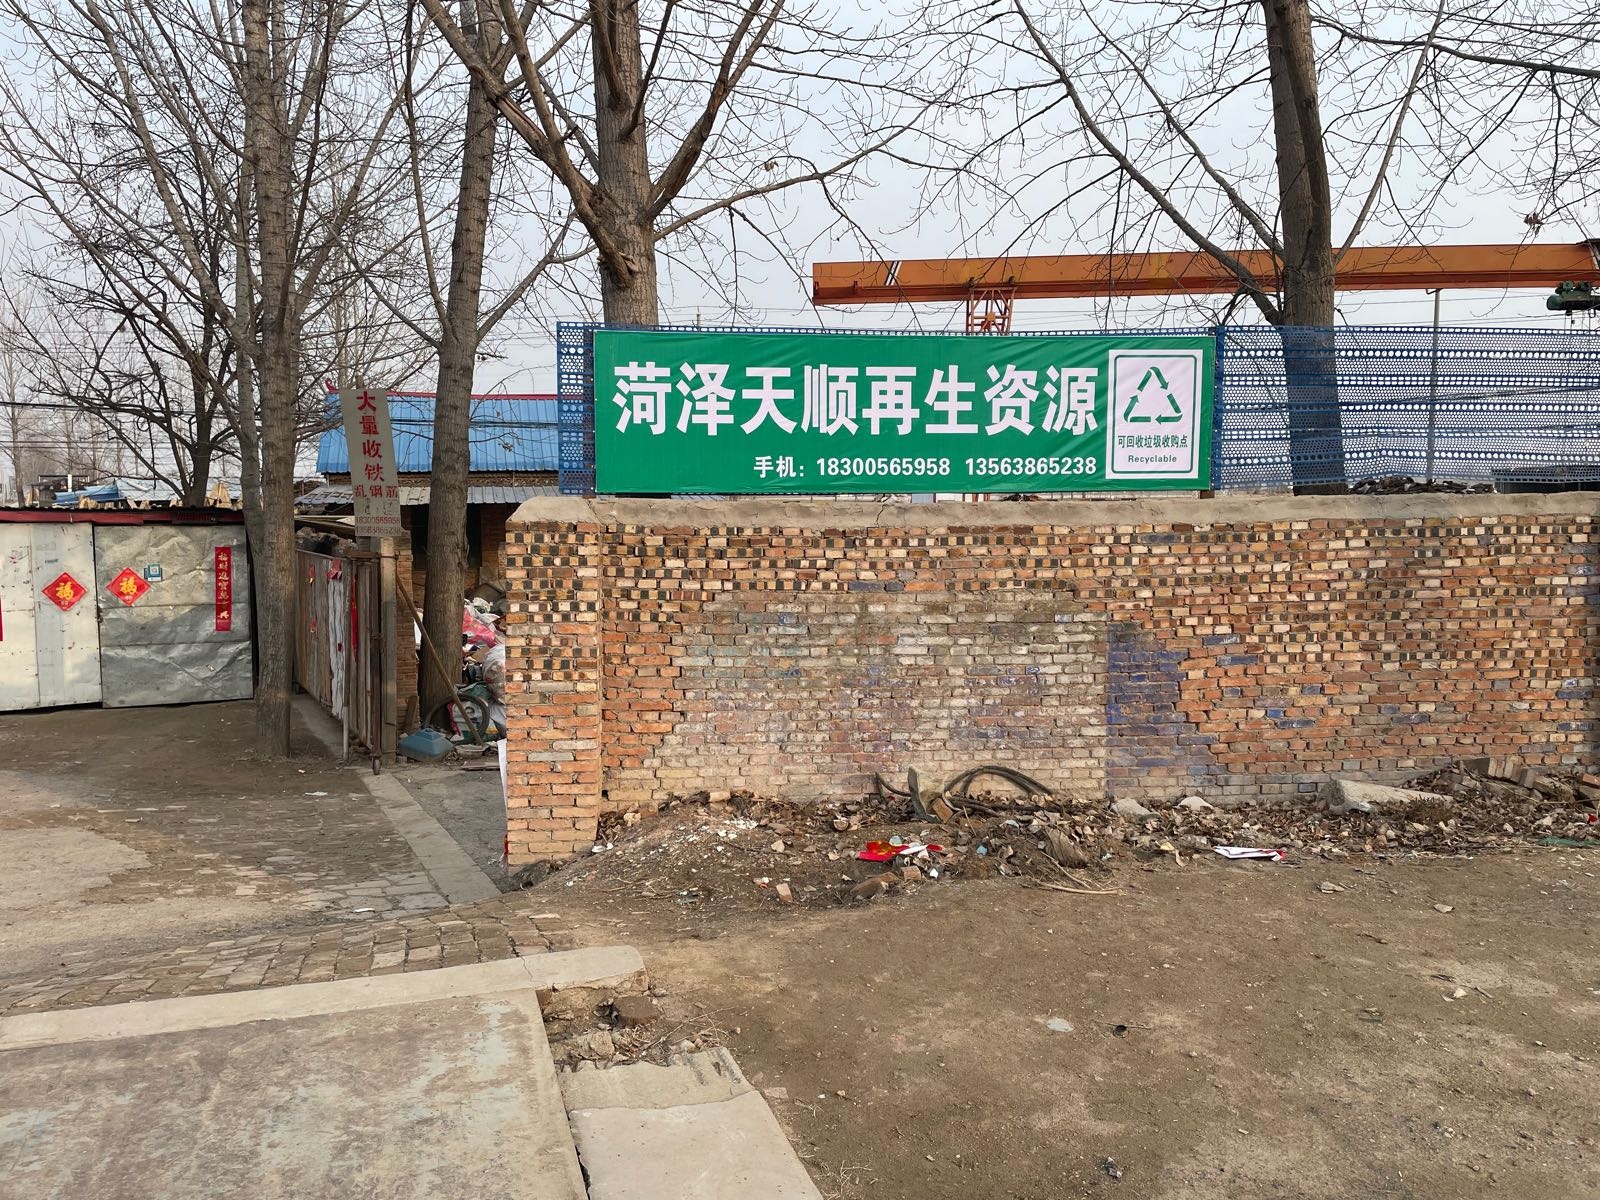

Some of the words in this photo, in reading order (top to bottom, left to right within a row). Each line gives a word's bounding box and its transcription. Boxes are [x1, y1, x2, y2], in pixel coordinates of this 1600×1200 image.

[612, 361, 1099, 436] 菏泽天顺再生资源
[356, 391, 385, 482] 大量收铁
[1118, 435, 1188, 448] 可回收垃圾收购点
[816, 458, 950, 476] 18300565958
[966, 457, 1097, 475] 13563865238
[1128, 455, 1177, 464] Recyclable
[55, 581, 74, 600] 福
[119, 576, 138, 595] 福
